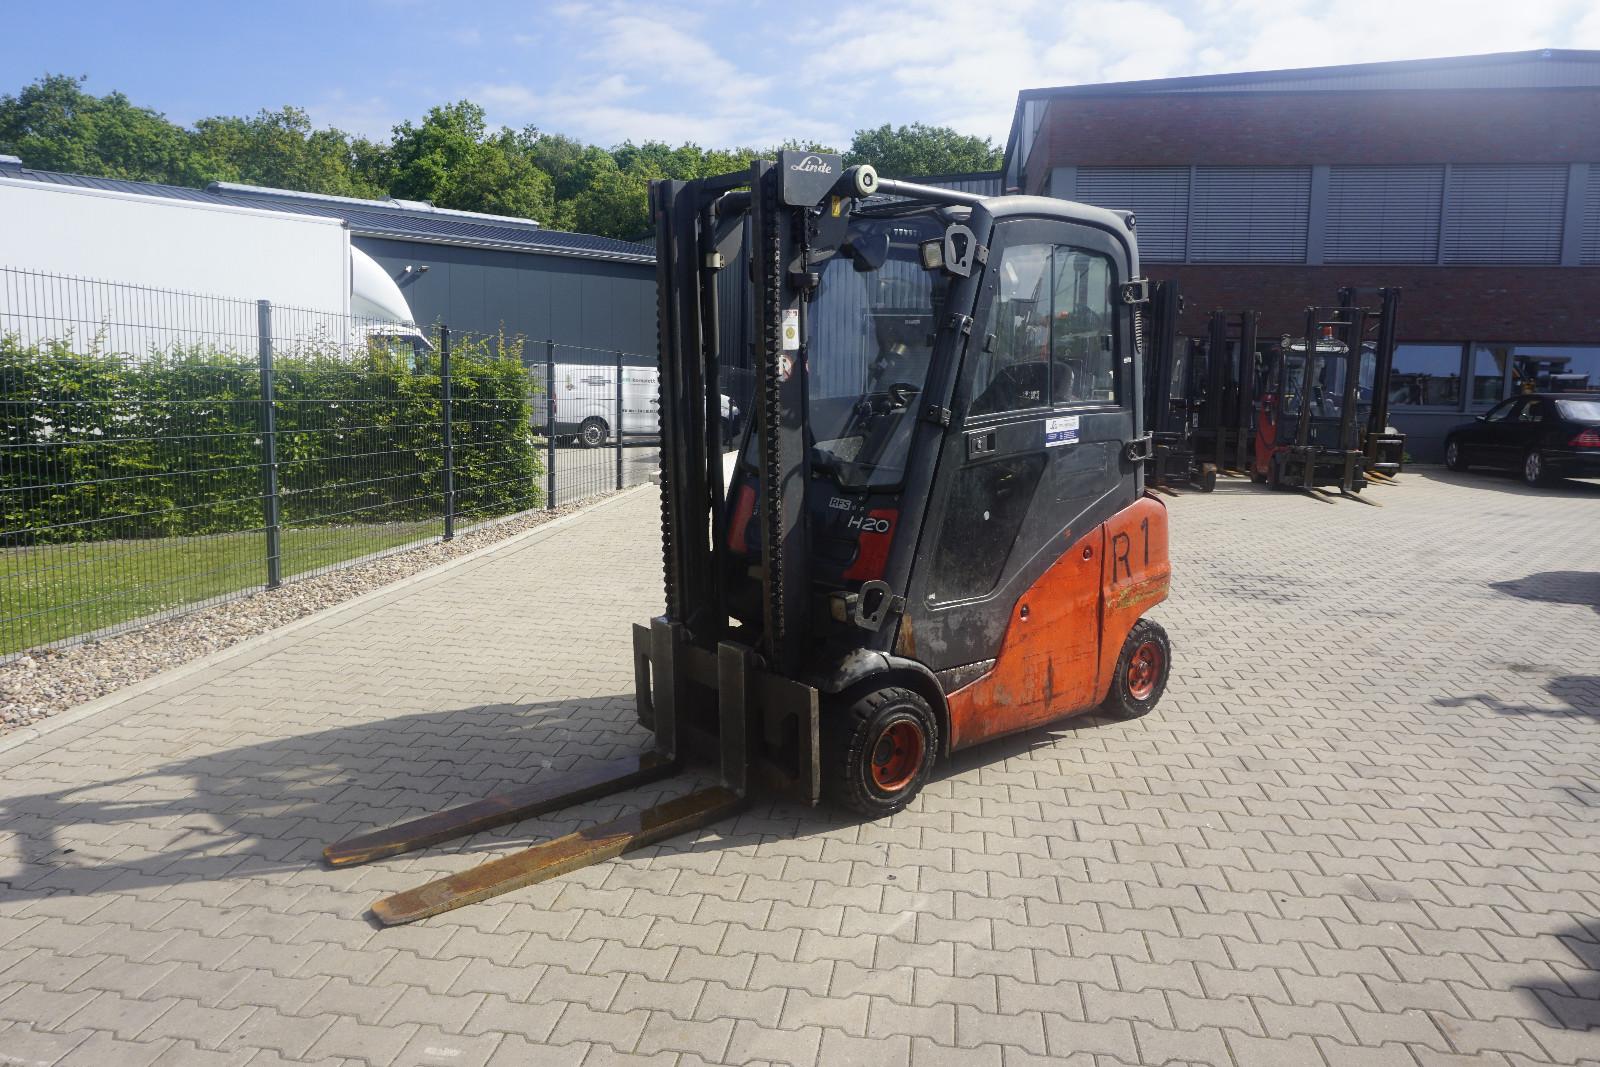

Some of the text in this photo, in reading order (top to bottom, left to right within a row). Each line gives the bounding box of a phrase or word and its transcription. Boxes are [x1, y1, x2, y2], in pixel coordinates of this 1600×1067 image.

[790, 155, 832, 174] Linde
[830, 498, 851, 510] RFS
[847, 515, 889, 533] H20
